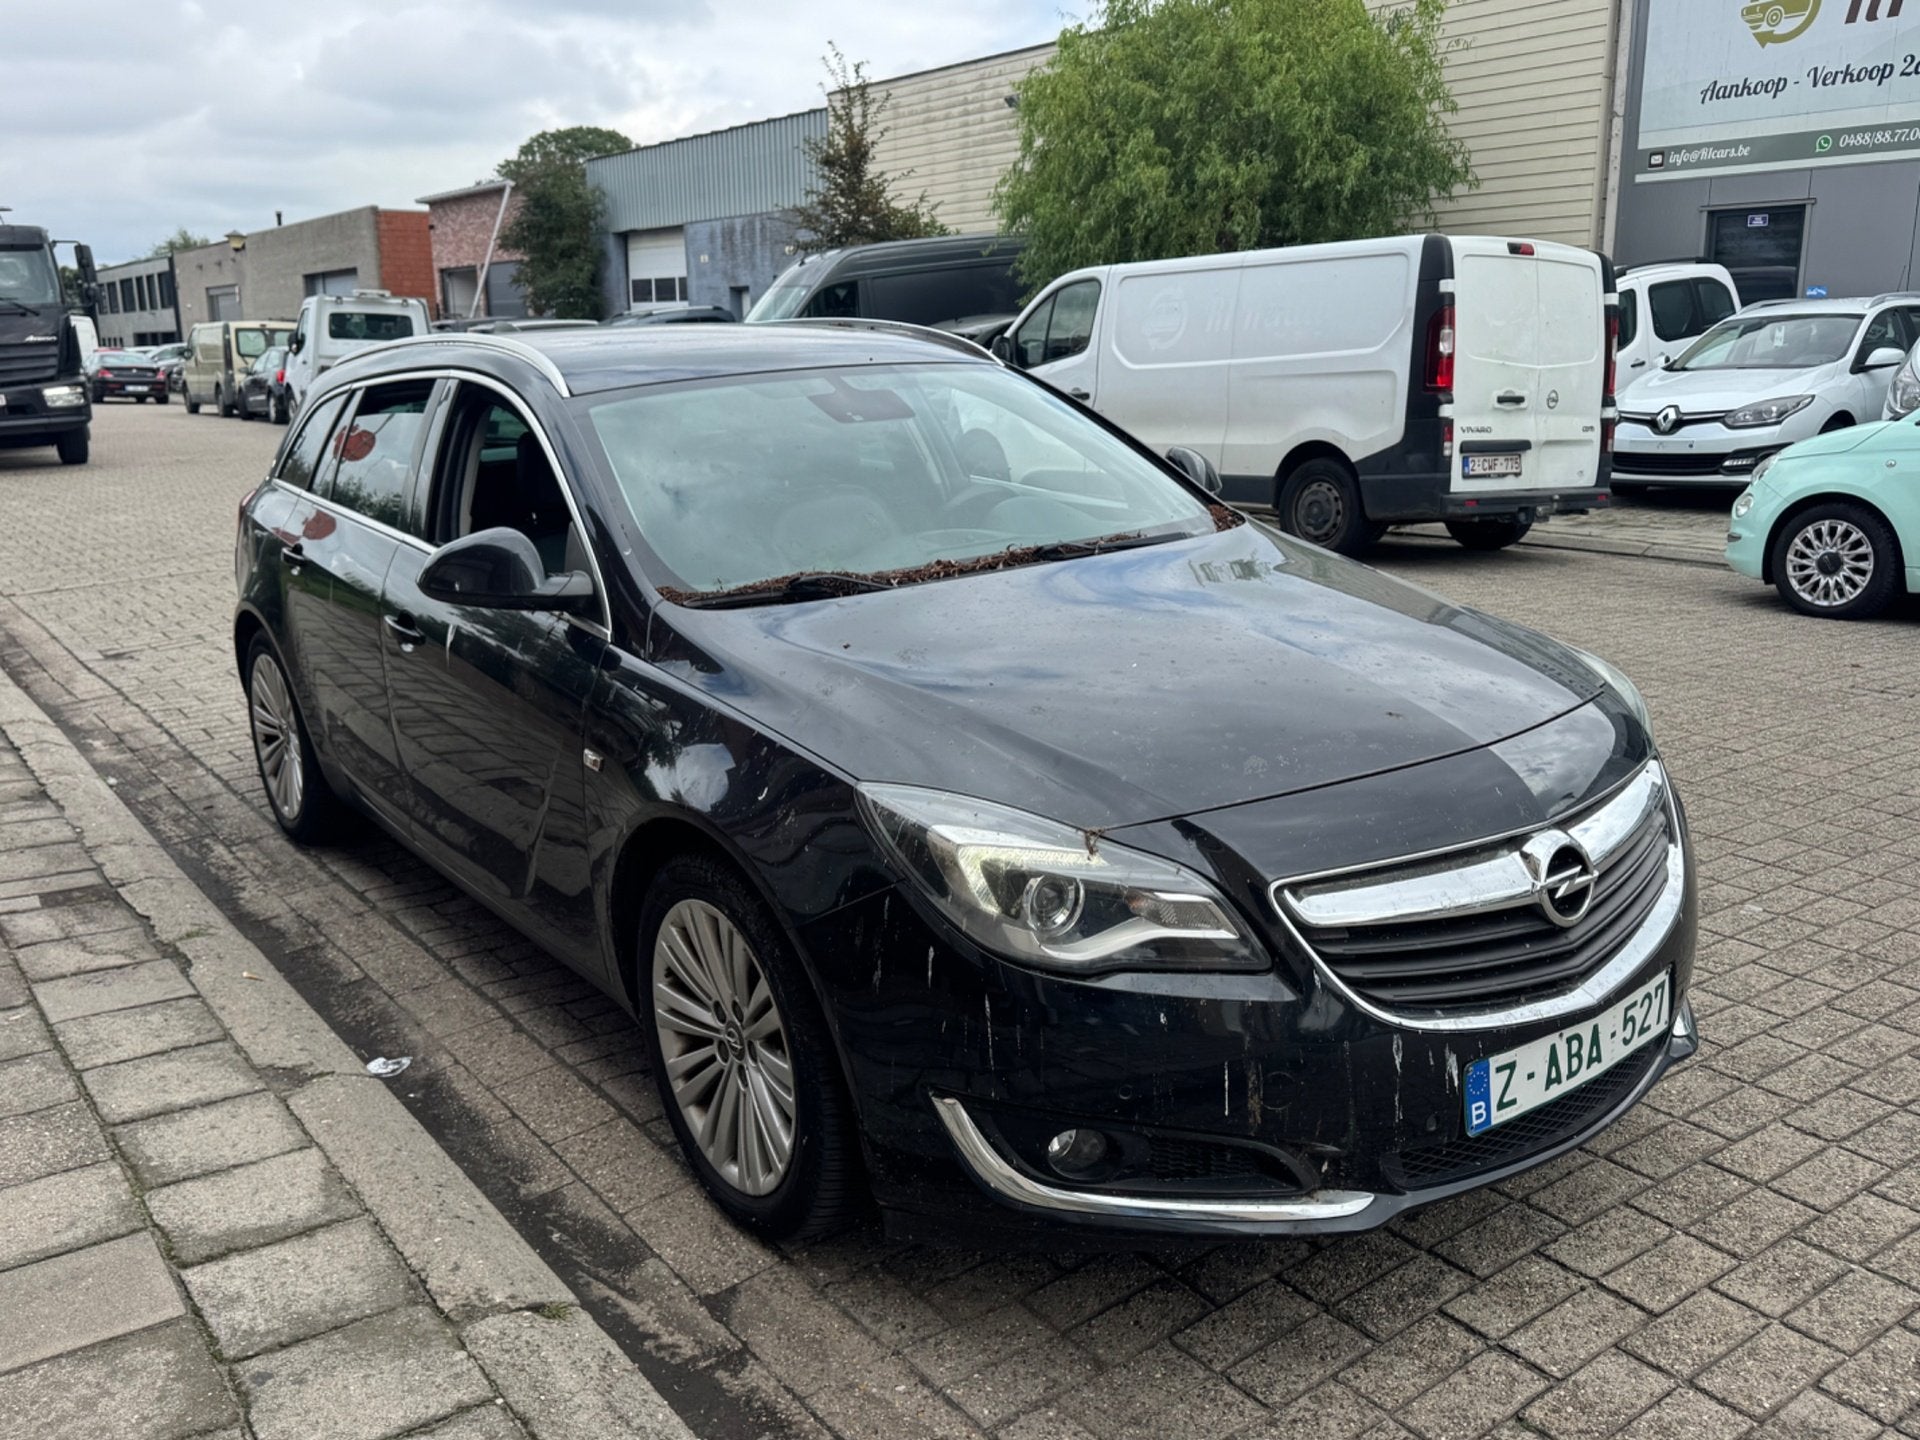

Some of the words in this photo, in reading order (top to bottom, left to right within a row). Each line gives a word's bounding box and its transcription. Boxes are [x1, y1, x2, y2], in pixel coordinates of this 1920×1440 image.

[1700, 75, 1788, 104] Aankoop
[1806, 63, 1895, 88] Verkoop
[1460, 425, 1493, 433] VIVARO
[1471, 1101, 1487, 1127] B
